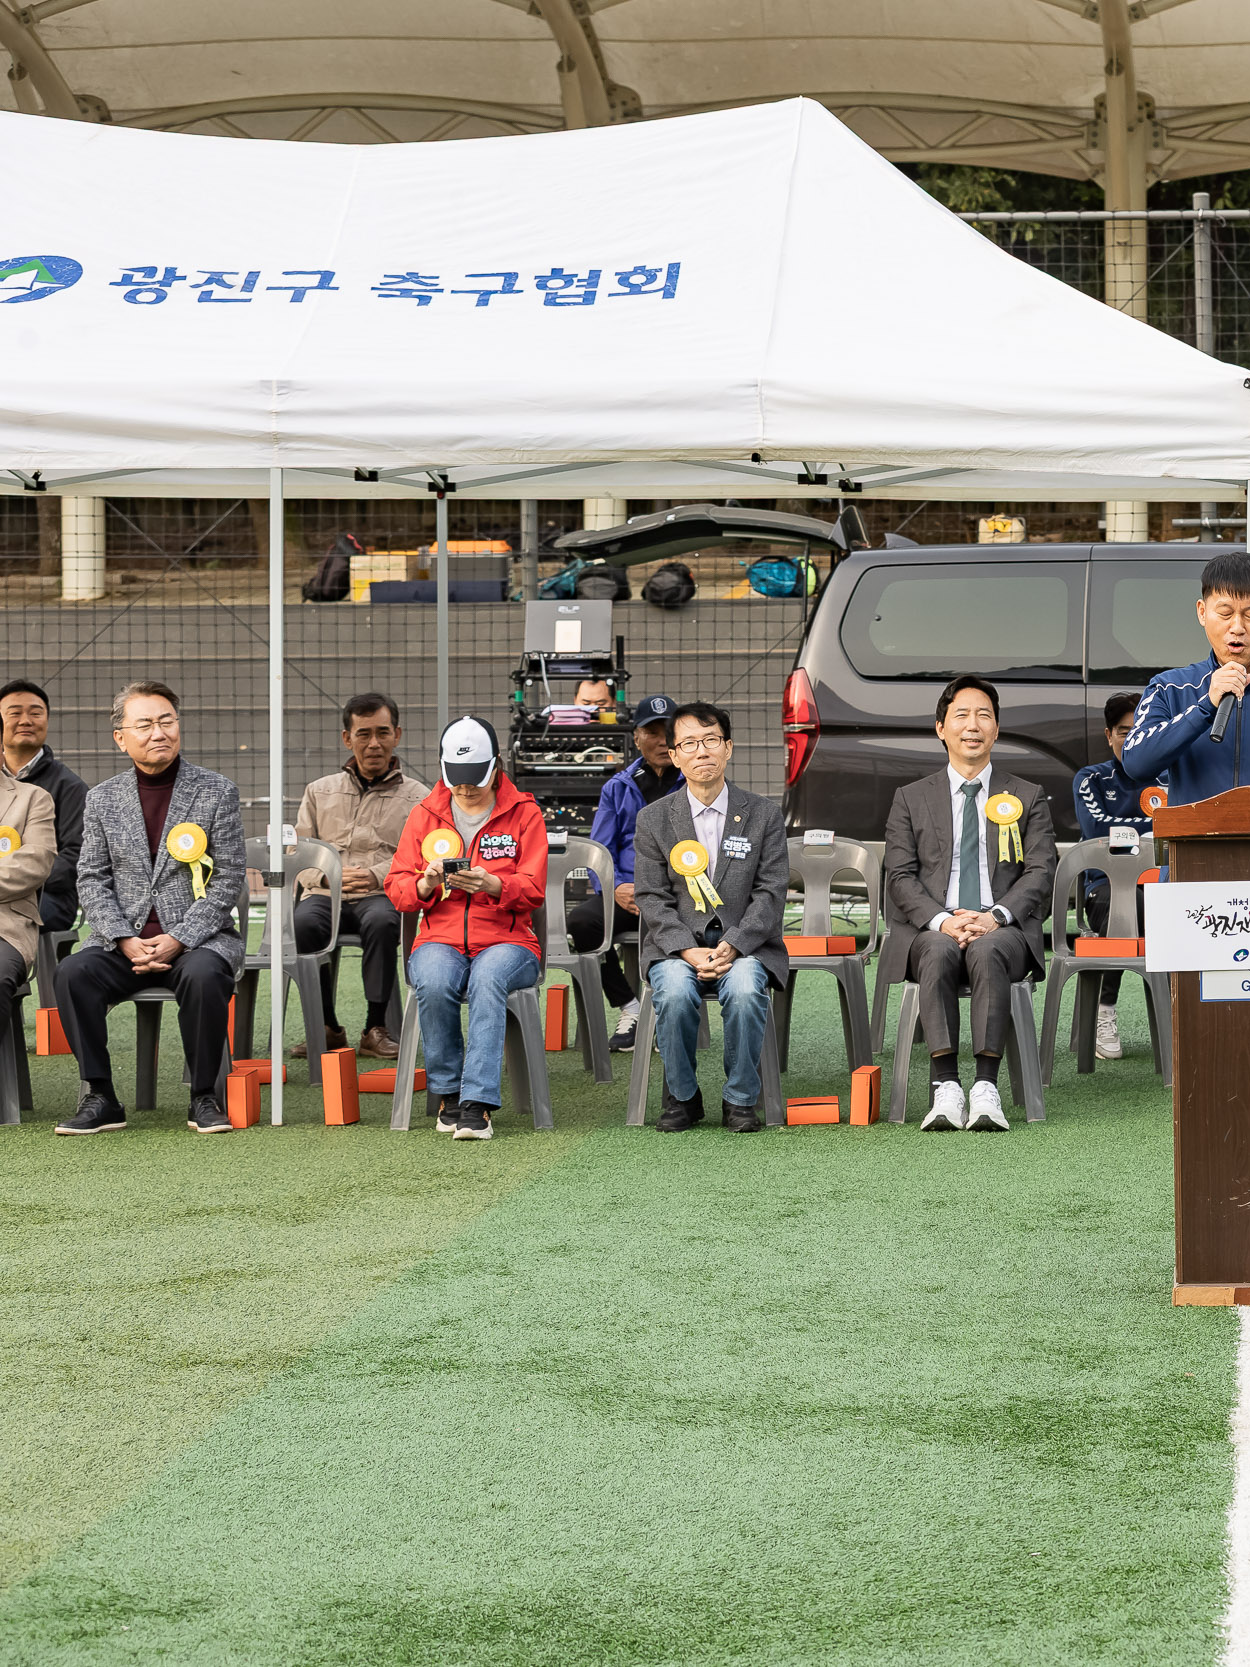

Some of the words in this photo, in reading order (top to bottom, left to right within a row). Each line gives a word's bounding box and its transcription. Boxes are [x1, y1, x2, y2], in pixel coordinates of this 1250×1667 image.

[109, 266, 340, 305] 광진구
[370, 262, 681, 307] 축구협회
[1114, 832, 1136, 840] 구의원
[1227, 898, 1249, 911] 개청
